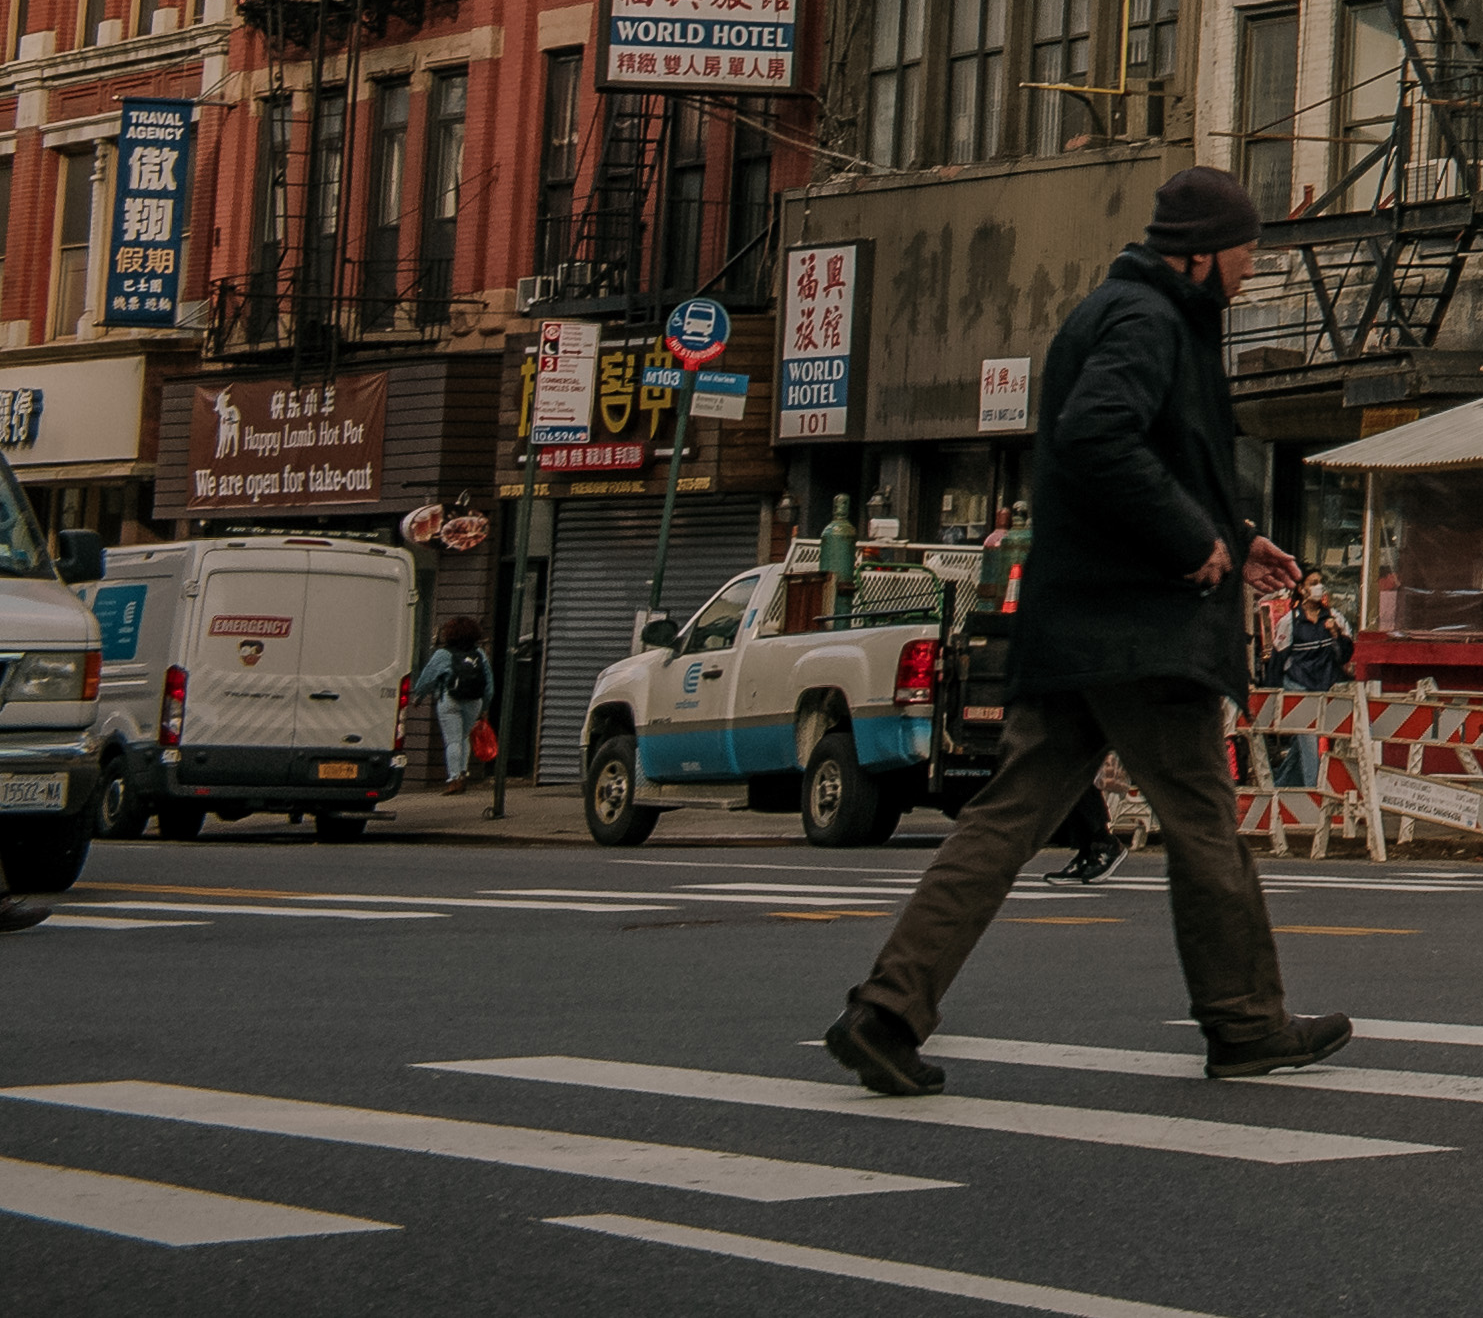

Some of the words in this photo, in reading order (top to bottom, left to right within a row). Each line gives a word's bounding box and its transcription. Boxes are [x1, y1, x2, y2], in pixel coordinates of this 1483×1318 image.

[616, 20, 705, 44] WORLD
[711, 24, 789, 48] HOTEL
[129, 110, 184, 127] TRAVAL
[125, 125, 185, 141] AGENCY
[122, 146, 180, 242] 傲翔
[115, 246, 175, 275] 假期
[797, 252, 846, 303] 福興
[793, 304, 843, 352] 旅館
[543, 356, 555, 371] 3
[788, 360, 845, 383] WORLD
[645, 369, 681, 386] M103
[787, 381, 838, 406] HOTEL
[798, 412, 828, 434] 101
[243, 424, 282, 458] Happy
[282, 421, 317, 449] Lamb
[318, 420, 341, 447] Hot
[341, 418, 365, 446] Pot
[194, 468, 217, 498] We
[218, 473, 244, 497] are
[245, 471, 281, 503] open
[281, 463, 306, 494] for
[307, 461, 374, 494] take-out
[212, 617, 289, 635] EMERGENCY
